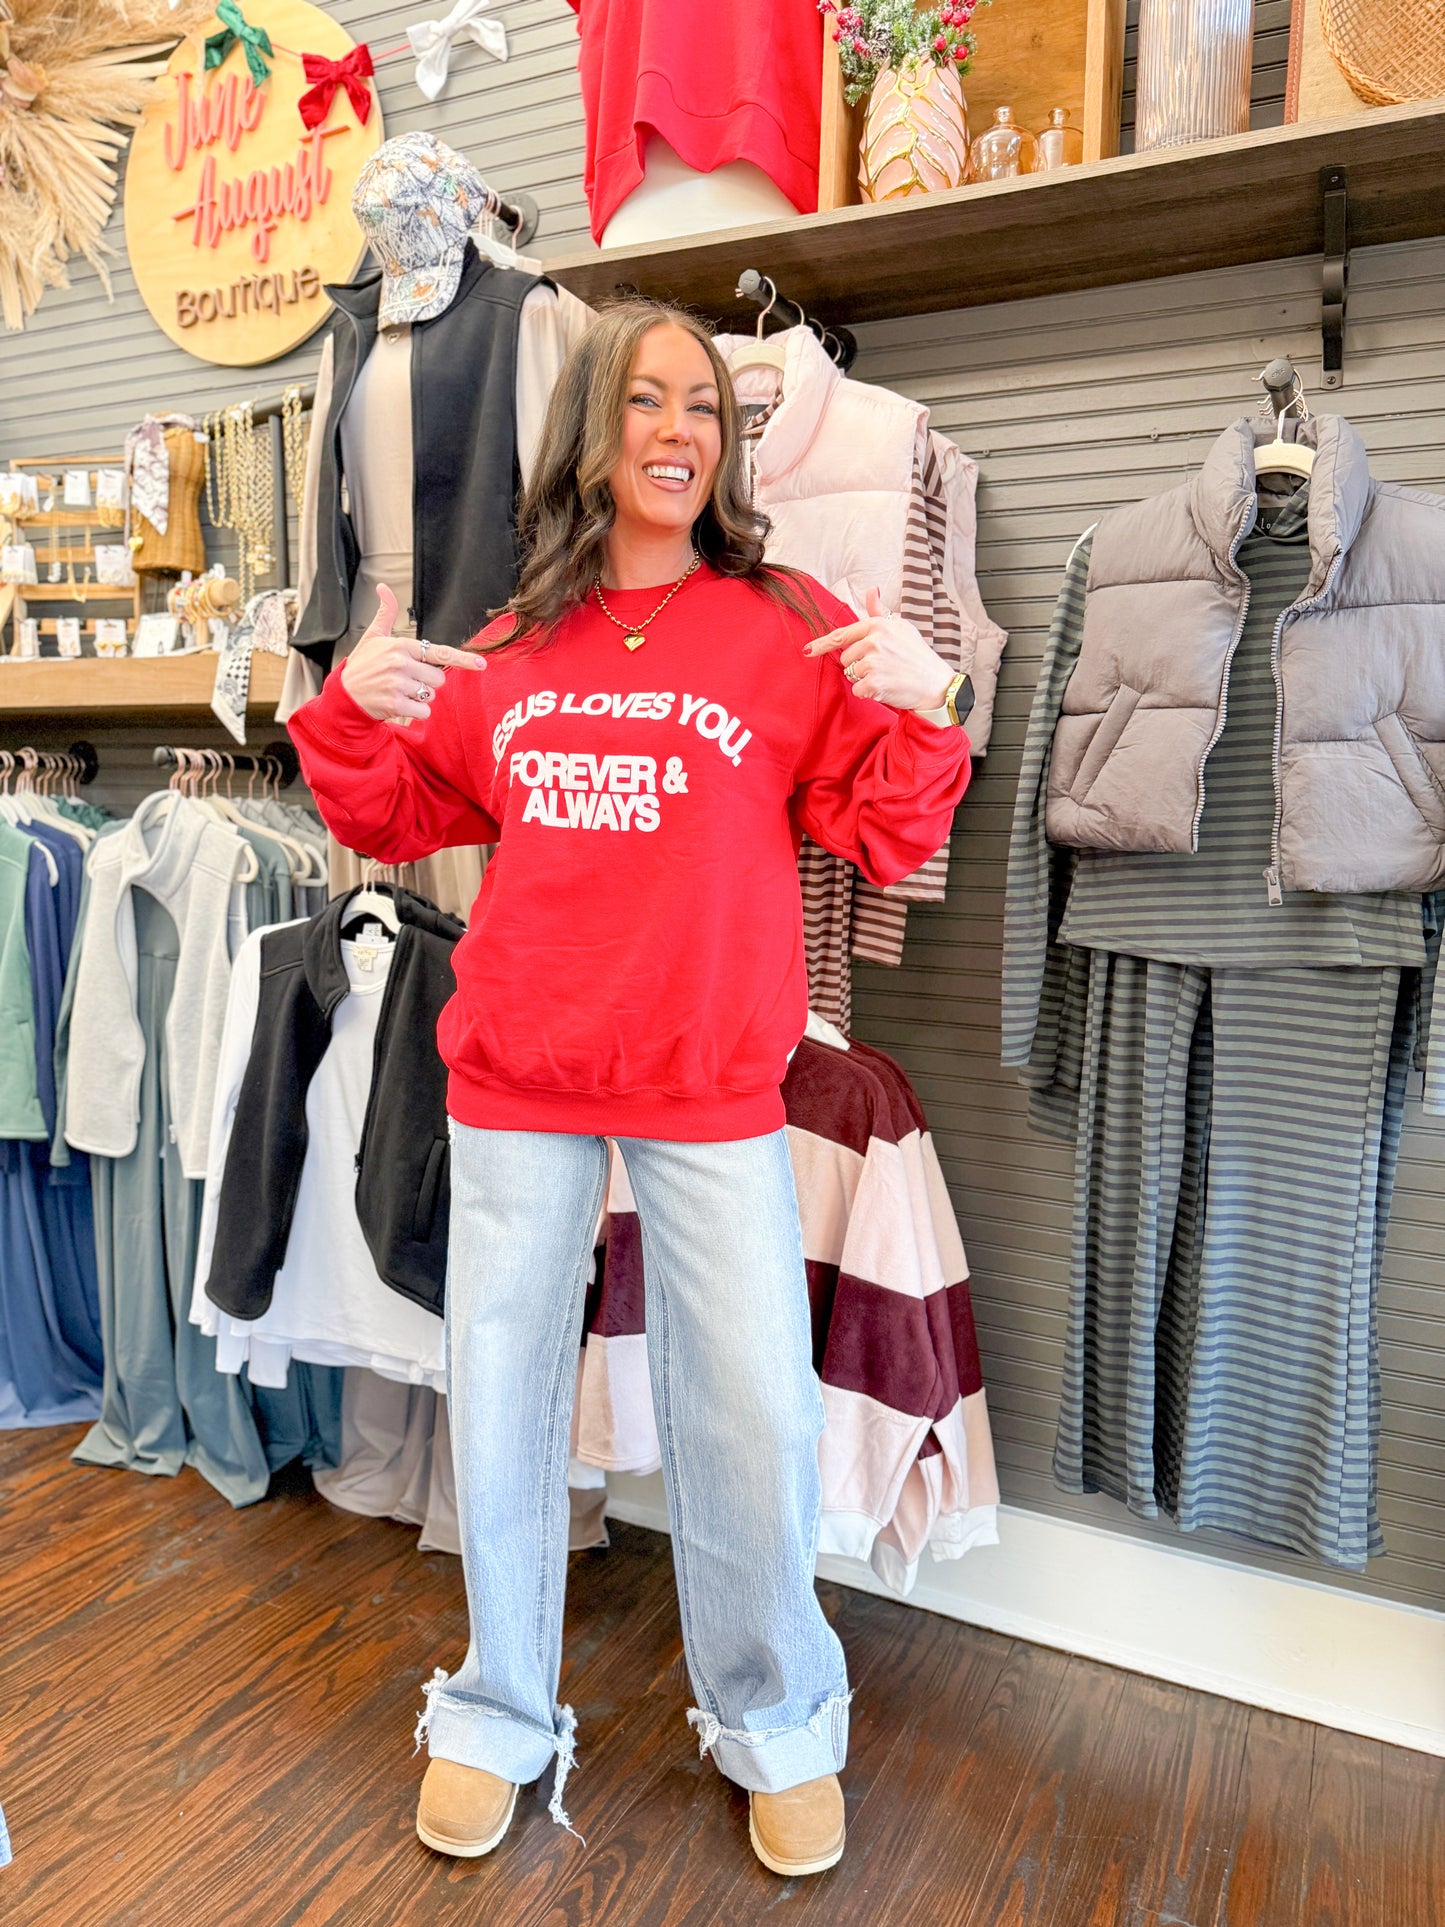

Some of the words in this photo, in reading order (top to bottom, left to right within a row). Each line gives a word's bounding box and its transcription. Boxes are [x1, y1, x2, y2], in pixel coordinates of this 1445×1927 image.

[172, 123, 350, 262] August
[176, 265, 320, 328] Boutique
[492, 690, 557, 772] ESUS
[560, 692, 675, 720] LOVES
[509, 750, 657, 794] FOREVER
[661, 756, 689, 795] &
[521, 788, 661, 833] ALWAYS
